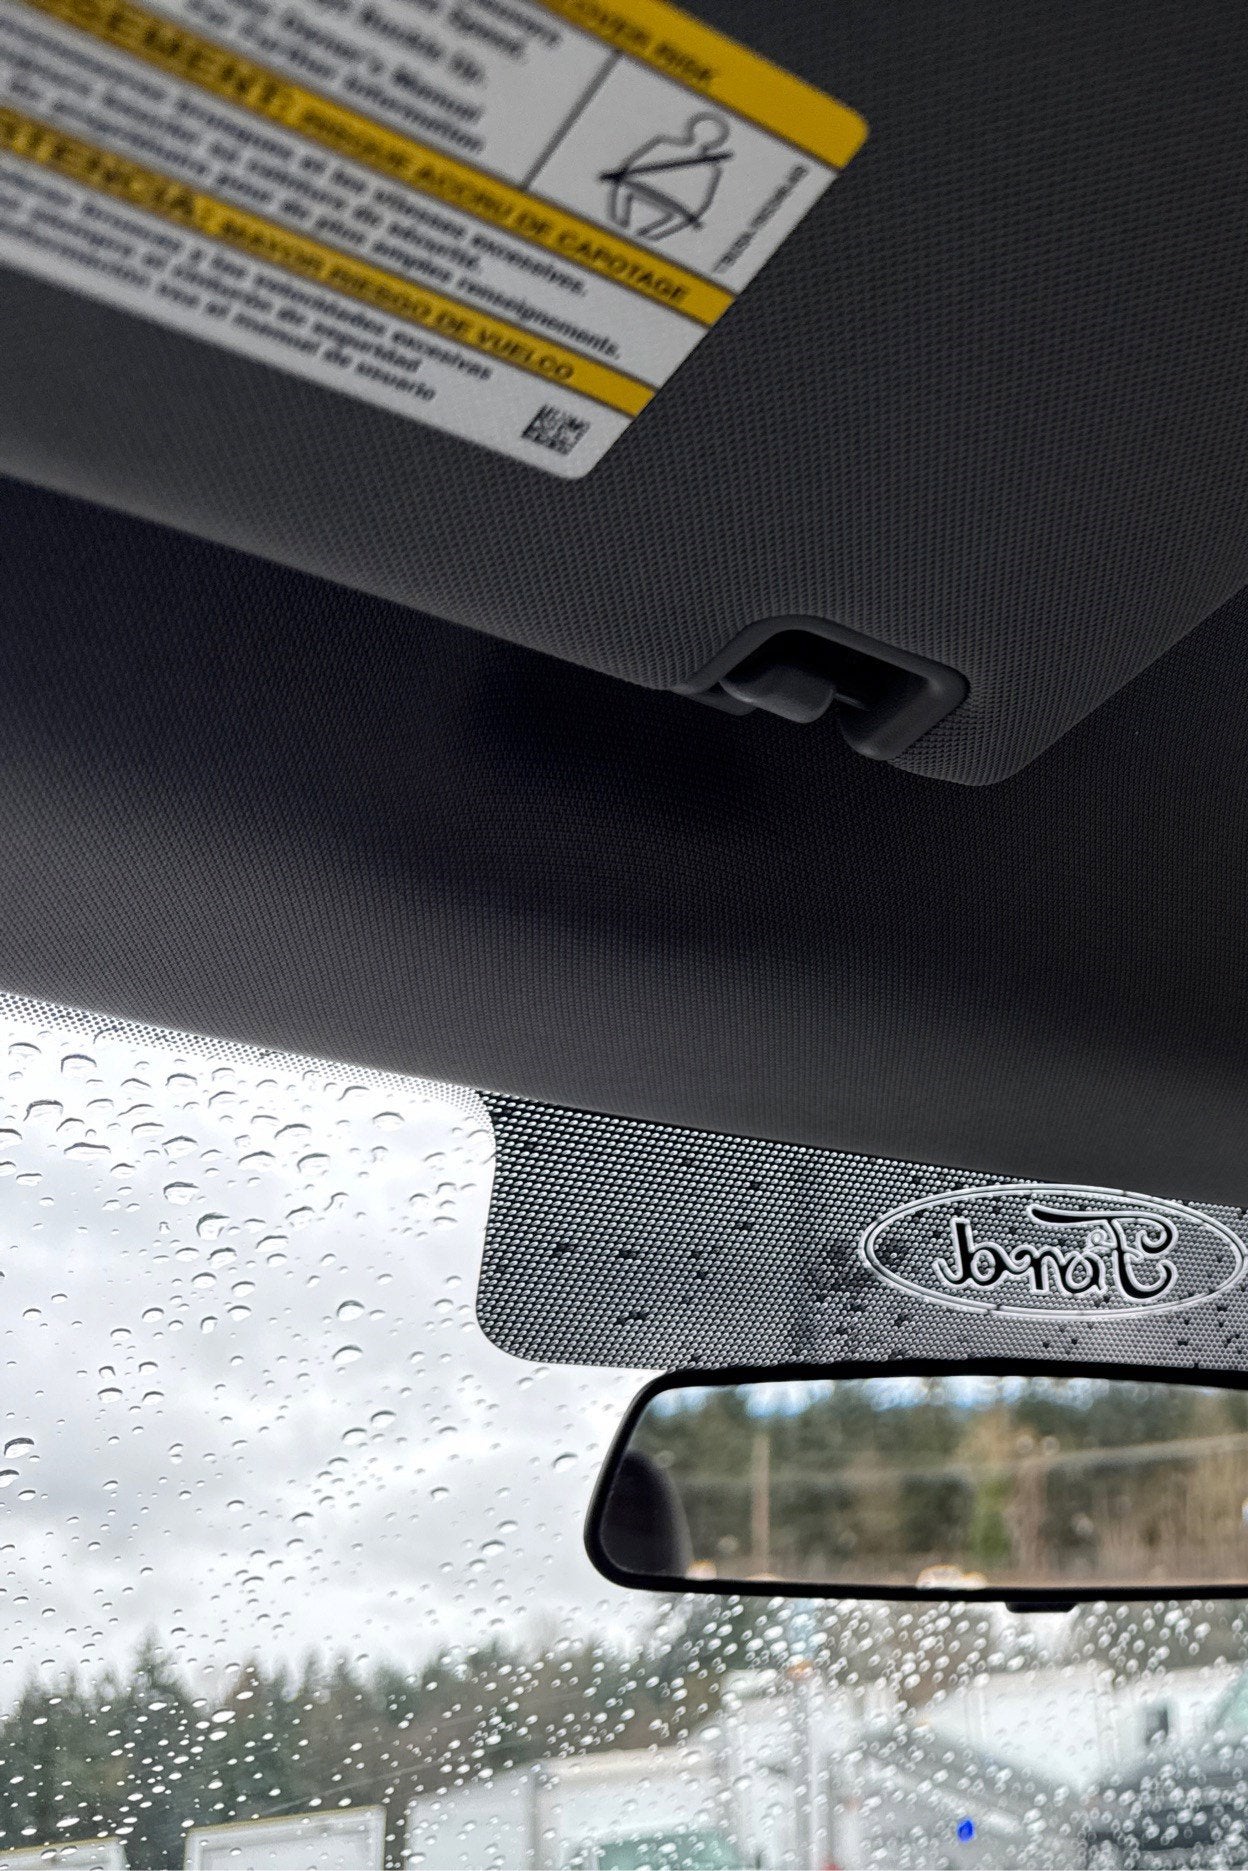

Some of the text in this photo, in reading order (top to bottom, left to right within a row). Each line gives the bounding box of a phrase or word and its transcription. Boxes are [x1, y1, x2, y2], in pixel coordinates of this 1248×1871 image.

[467, 232, 591, 299] excessives.
[552, 225, 688, 304] CAPOTAGE
[432, 306, 473, 337] DE
[474, 323, 579, 382] VUELCO
[453, 275, 626, 362] renseignements.
[354, 359, 437, 401] usuario
[387, 327, 494, 382] excesivas
